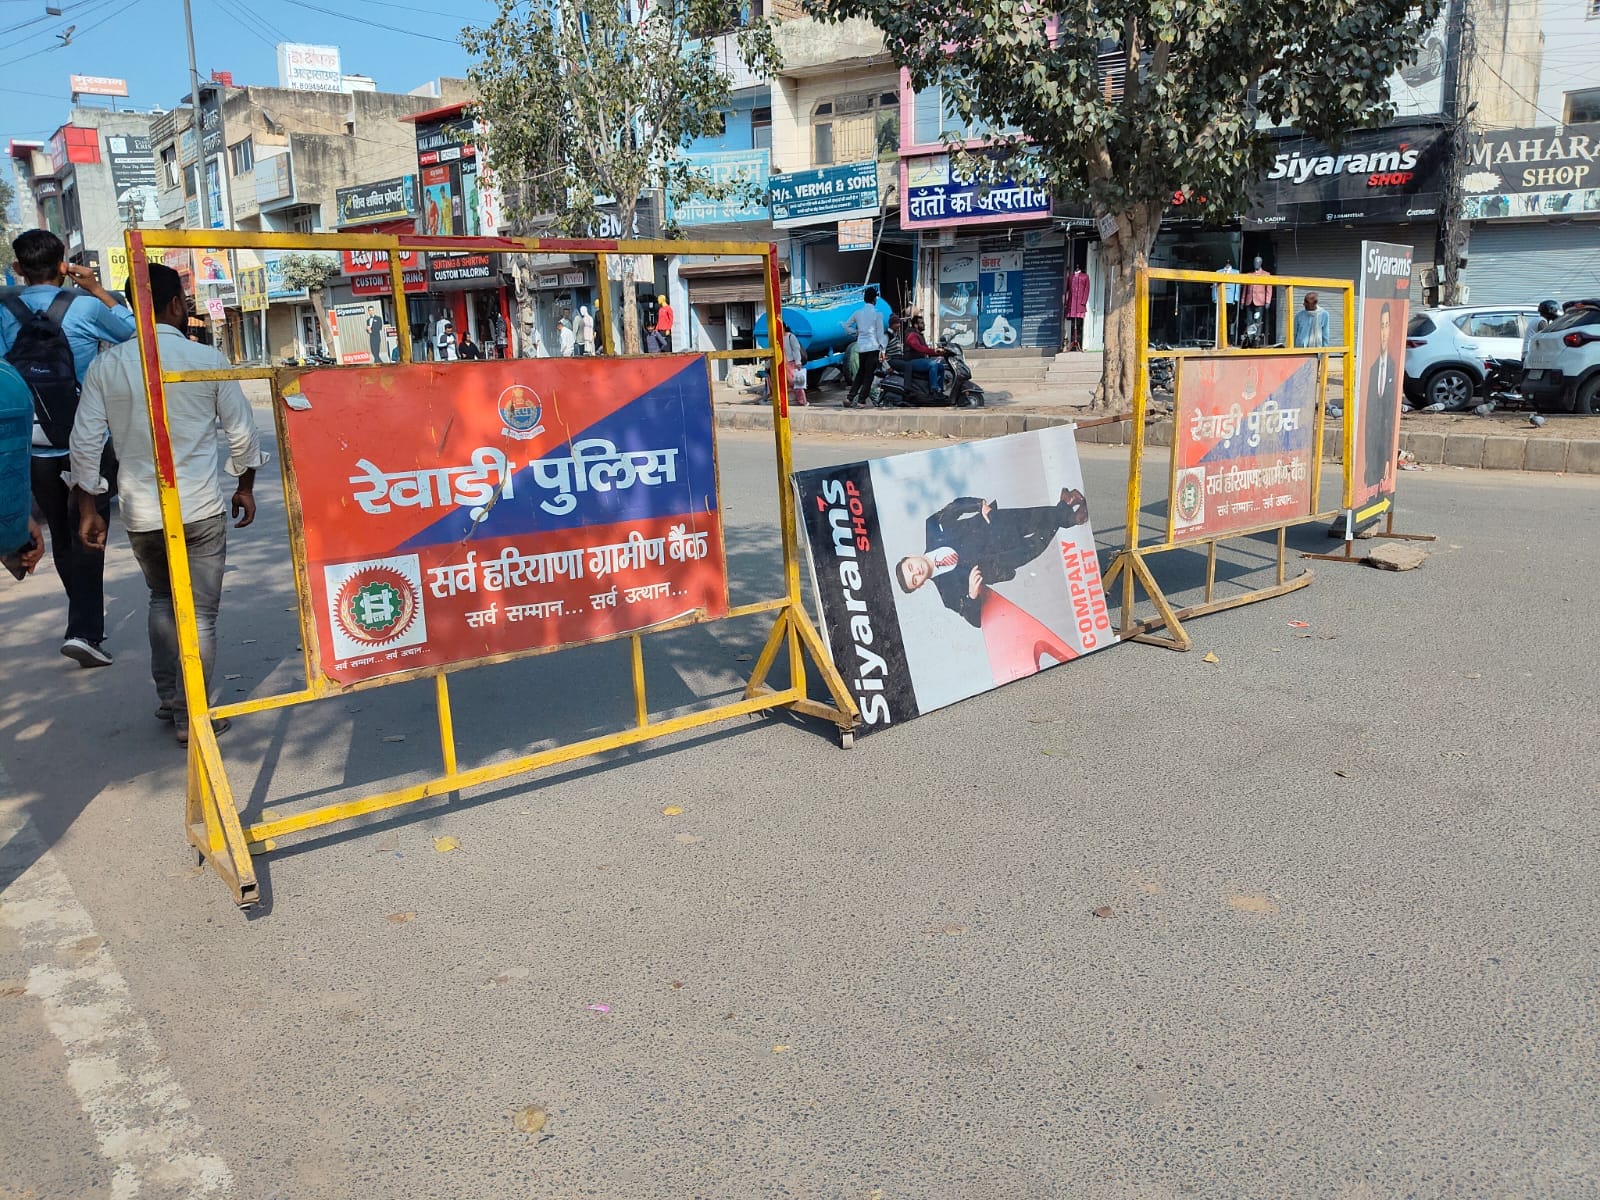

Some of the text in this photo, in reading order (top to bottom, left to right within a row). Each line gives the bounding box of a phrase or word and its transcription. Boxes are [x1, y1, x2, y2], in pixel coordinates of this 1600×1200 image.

[772, 174, 877, 203] M/s. VERMA & SONS
[1367, 172, 1414, 187] SHOP
[1521, 165, 1590, 188] SHOP
[950, 192, 974, 214] का
[977, 186, 1048, 210] अस्पताल
[434, 266, 490, 281] CUSTOM TAILORING
[461, 255, 489, 267] SHIRTING
[355, 275, 384, 288] CUSTOM
[1190, 400, 1301, 449] रेवाड़ी पुलिस
[349, 437, 678, 523] रेवाड़ी पुलिस
[1206, 465, 1224, 495] सर्व
[1224, 465, 1261, 493] हरियाणा
[845, 479, 870, 552] SHOP
[427, 523, 708, 599] सर्व हरियाणा ग्रामीण बैंक
[1061, 540, 1097, 649] COMPANY
[1081, 549, 1109, 630] OUTLET
[465, 602, 497, 629] सर्व
[590, 585, 618, 610] सर्व
[334, 660, 348, 672] सर्व
[385, 651, 398, 661] सर्व
